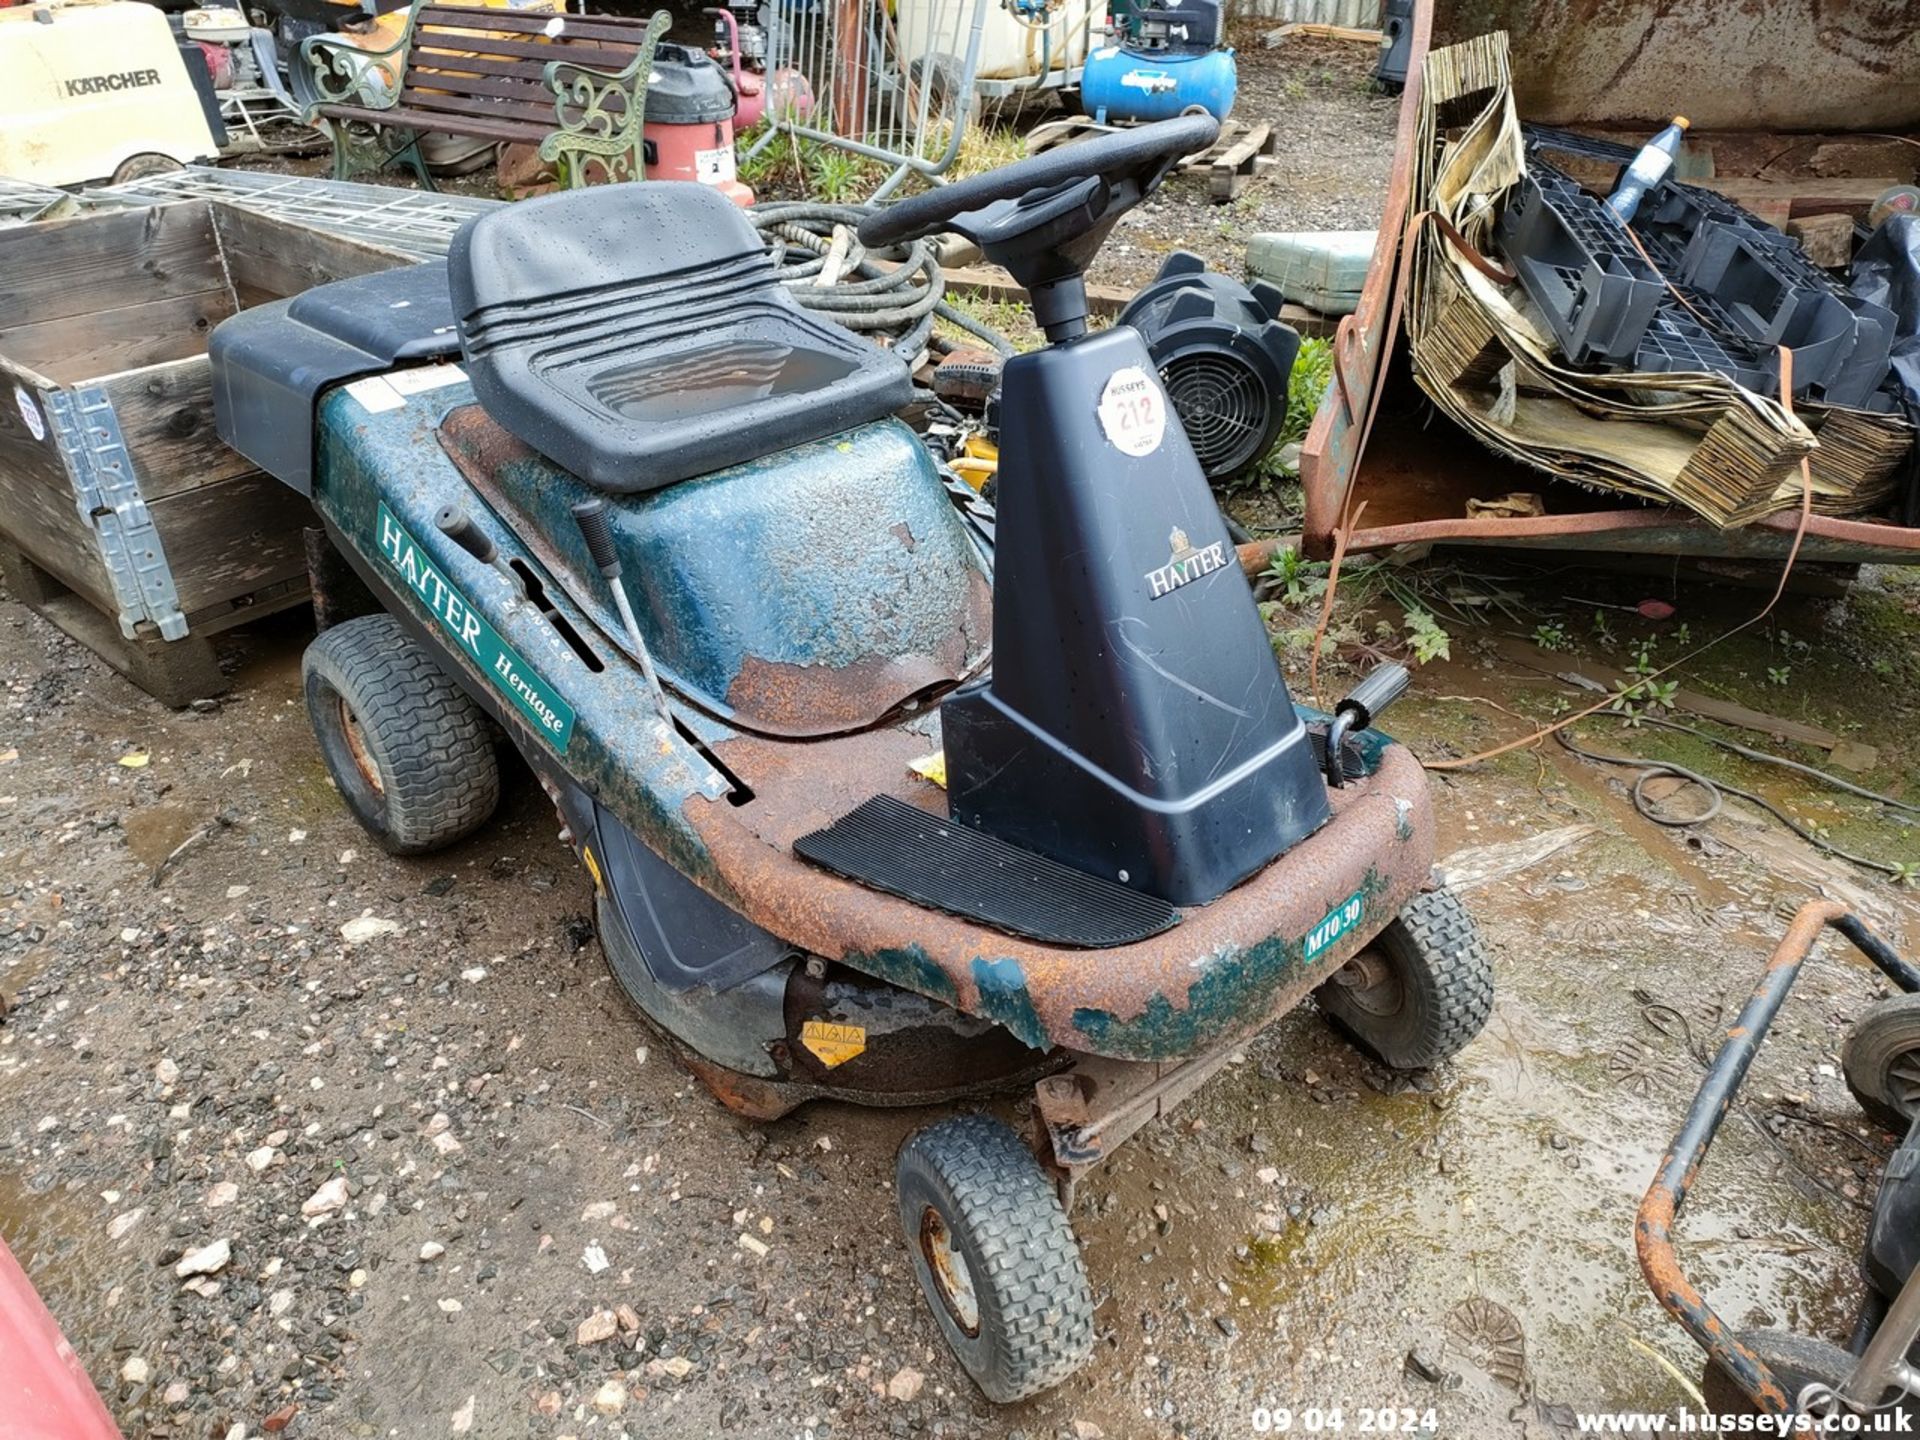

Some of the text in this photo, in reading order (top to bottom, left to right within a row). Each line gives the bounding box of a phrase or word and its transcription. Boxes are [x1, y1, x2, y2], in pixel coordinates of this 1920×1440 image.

[65, 69, 161, 96] KÄRCHER
[1117, 397, 1155, 430] 212
[1148, 543, 1227, 597] HAYTER
[380, 514, 565, 734] HAYTER Heritage
